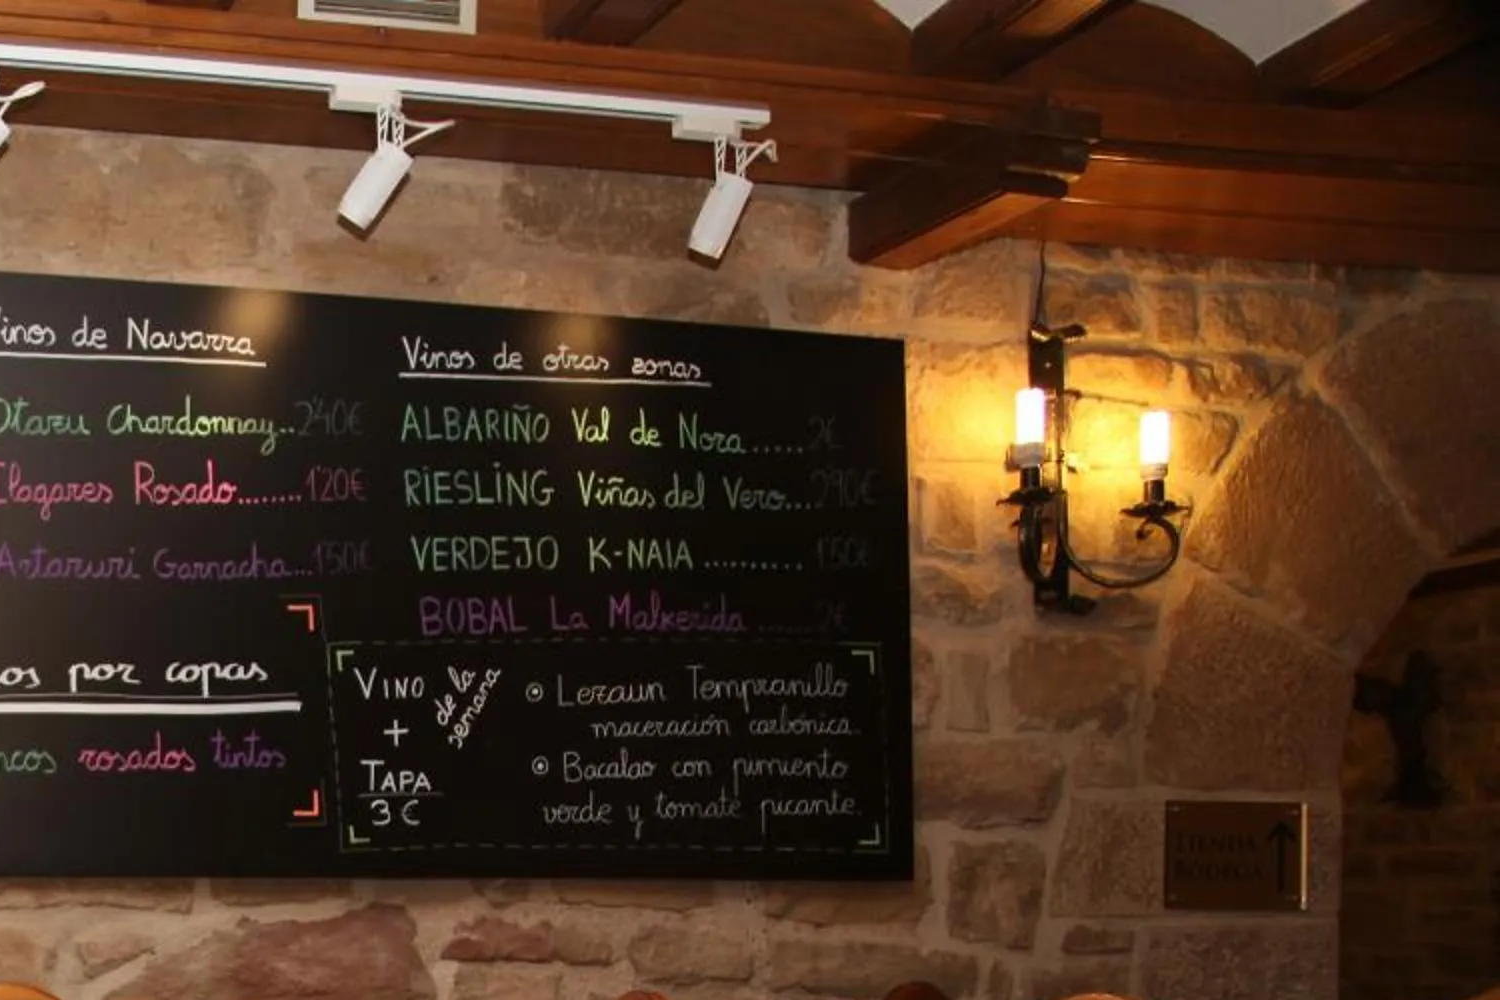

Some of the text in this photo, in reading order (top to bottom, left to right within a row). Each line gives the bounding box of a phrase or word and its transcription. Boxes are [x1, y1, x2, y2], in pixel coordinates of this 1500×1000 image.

[71, 316, 107, 348] de
[127, 317, 255, 356] Navarra
[402, 337, 702, 380] Vinos de otras zonas
[400, 403, 551, 445] ALBARIÑO
[572, 407, 611, 444] Val
[629, 408, 663, 447] de
[403, 461, 555, 507] RIESLING
[577, 471, 656, 510] Viñas
[664, 472, 706, 511] del
[411, 535, 560, 572] VERDEJO
[419, 595, 528, 637] BOBAL
[551, 596, 588, 631] La
[68, 659, 140, 693] por
[165, 659, 268, 698] copas
[353, 666, 425, 700] VINO
[687, 664, 849, 715] Tempranillo
[434, 694, 457, 727] de
[448, 668, 502, 751] semana
[592, 710, 732, 738] maceración
[78, 732, 197, 771] rosados
[211, 729, 286, 769] tintos
[360, 759, 433, 794] TAPA
[672, 758, 712, 779] con
[733, 751, 849, 795] pimiento
[543, 790, 612, 825] verde
[627, 803, 645, 840] y
[655, 792, 740, 819] tomate
